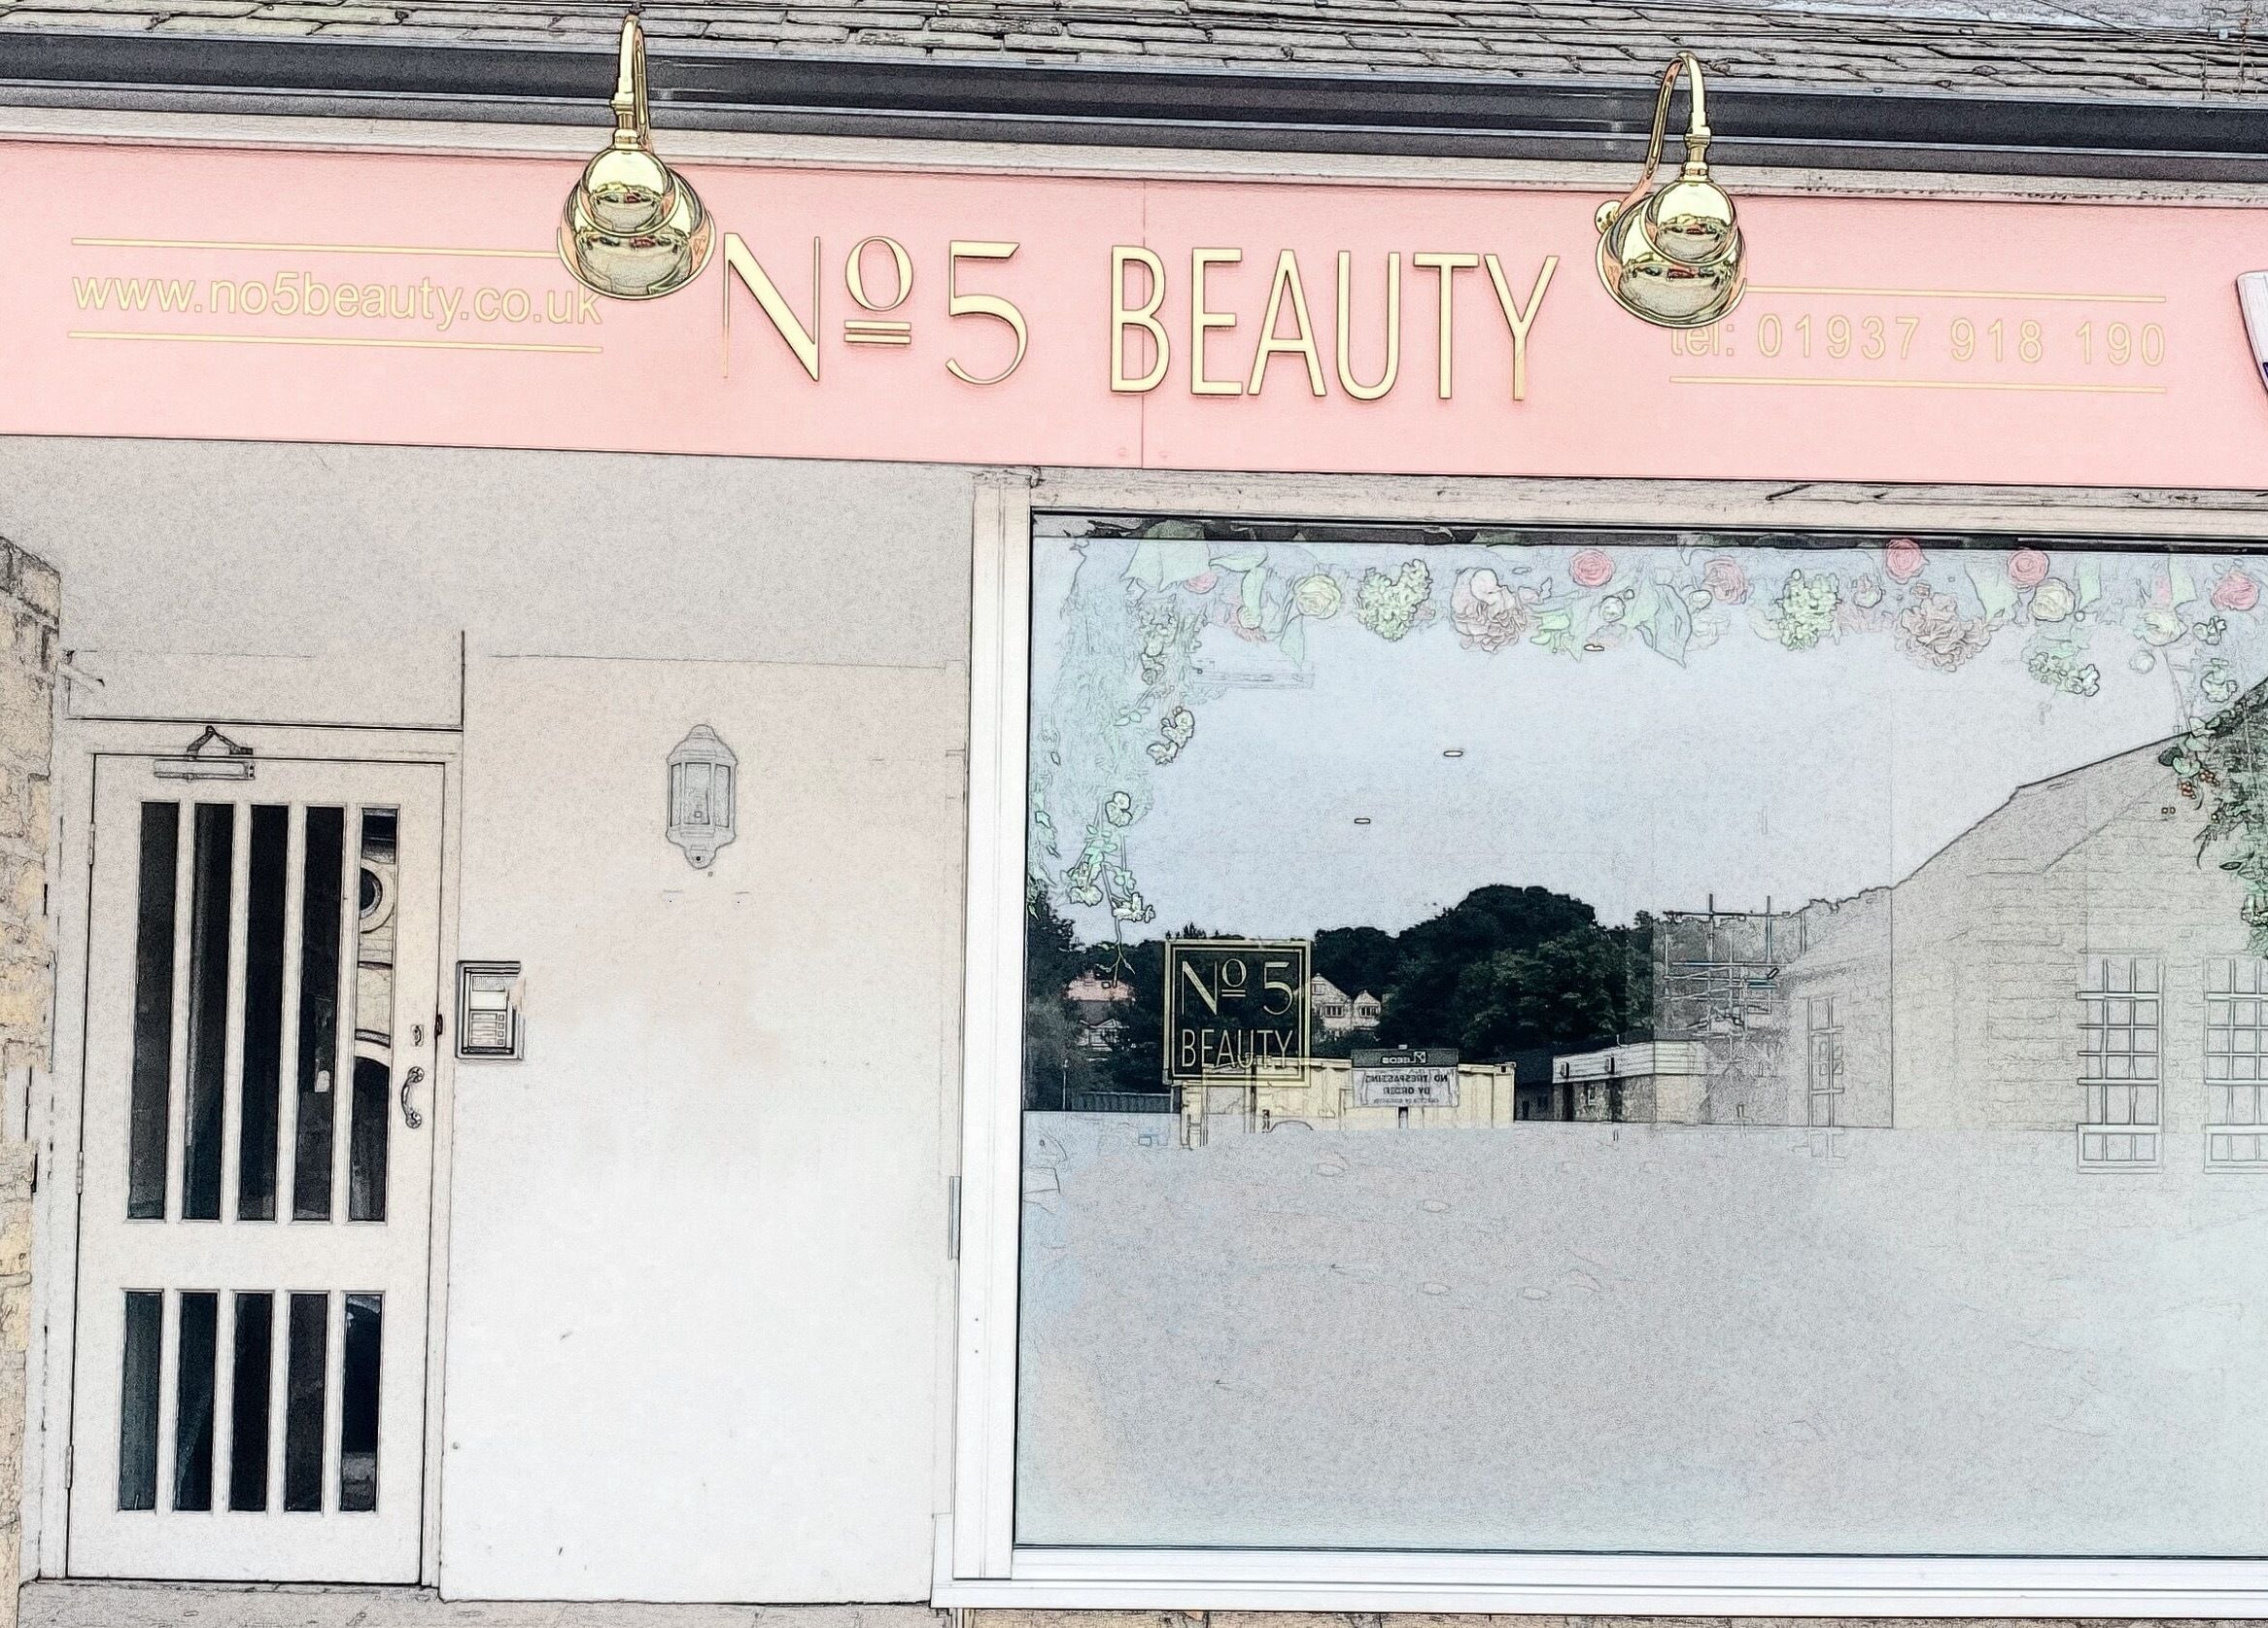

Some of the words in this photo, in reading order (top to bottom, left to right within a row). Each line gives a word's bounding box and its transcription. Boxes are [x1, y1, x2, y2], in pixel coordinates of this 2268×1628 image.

[71, 271, 603, 331] www.no5beauty.co.uk
[1109, 243, 1561, 403] BEAUTY
[1670, 322, 1735, 357] tel:
[1757, 313, 1920, 360] 01937
[1949, 318, 2044, 364] 918
[2075, 321, 2166, 366] 190
[1181, 1028, 1293, 1068] BEAUTY
